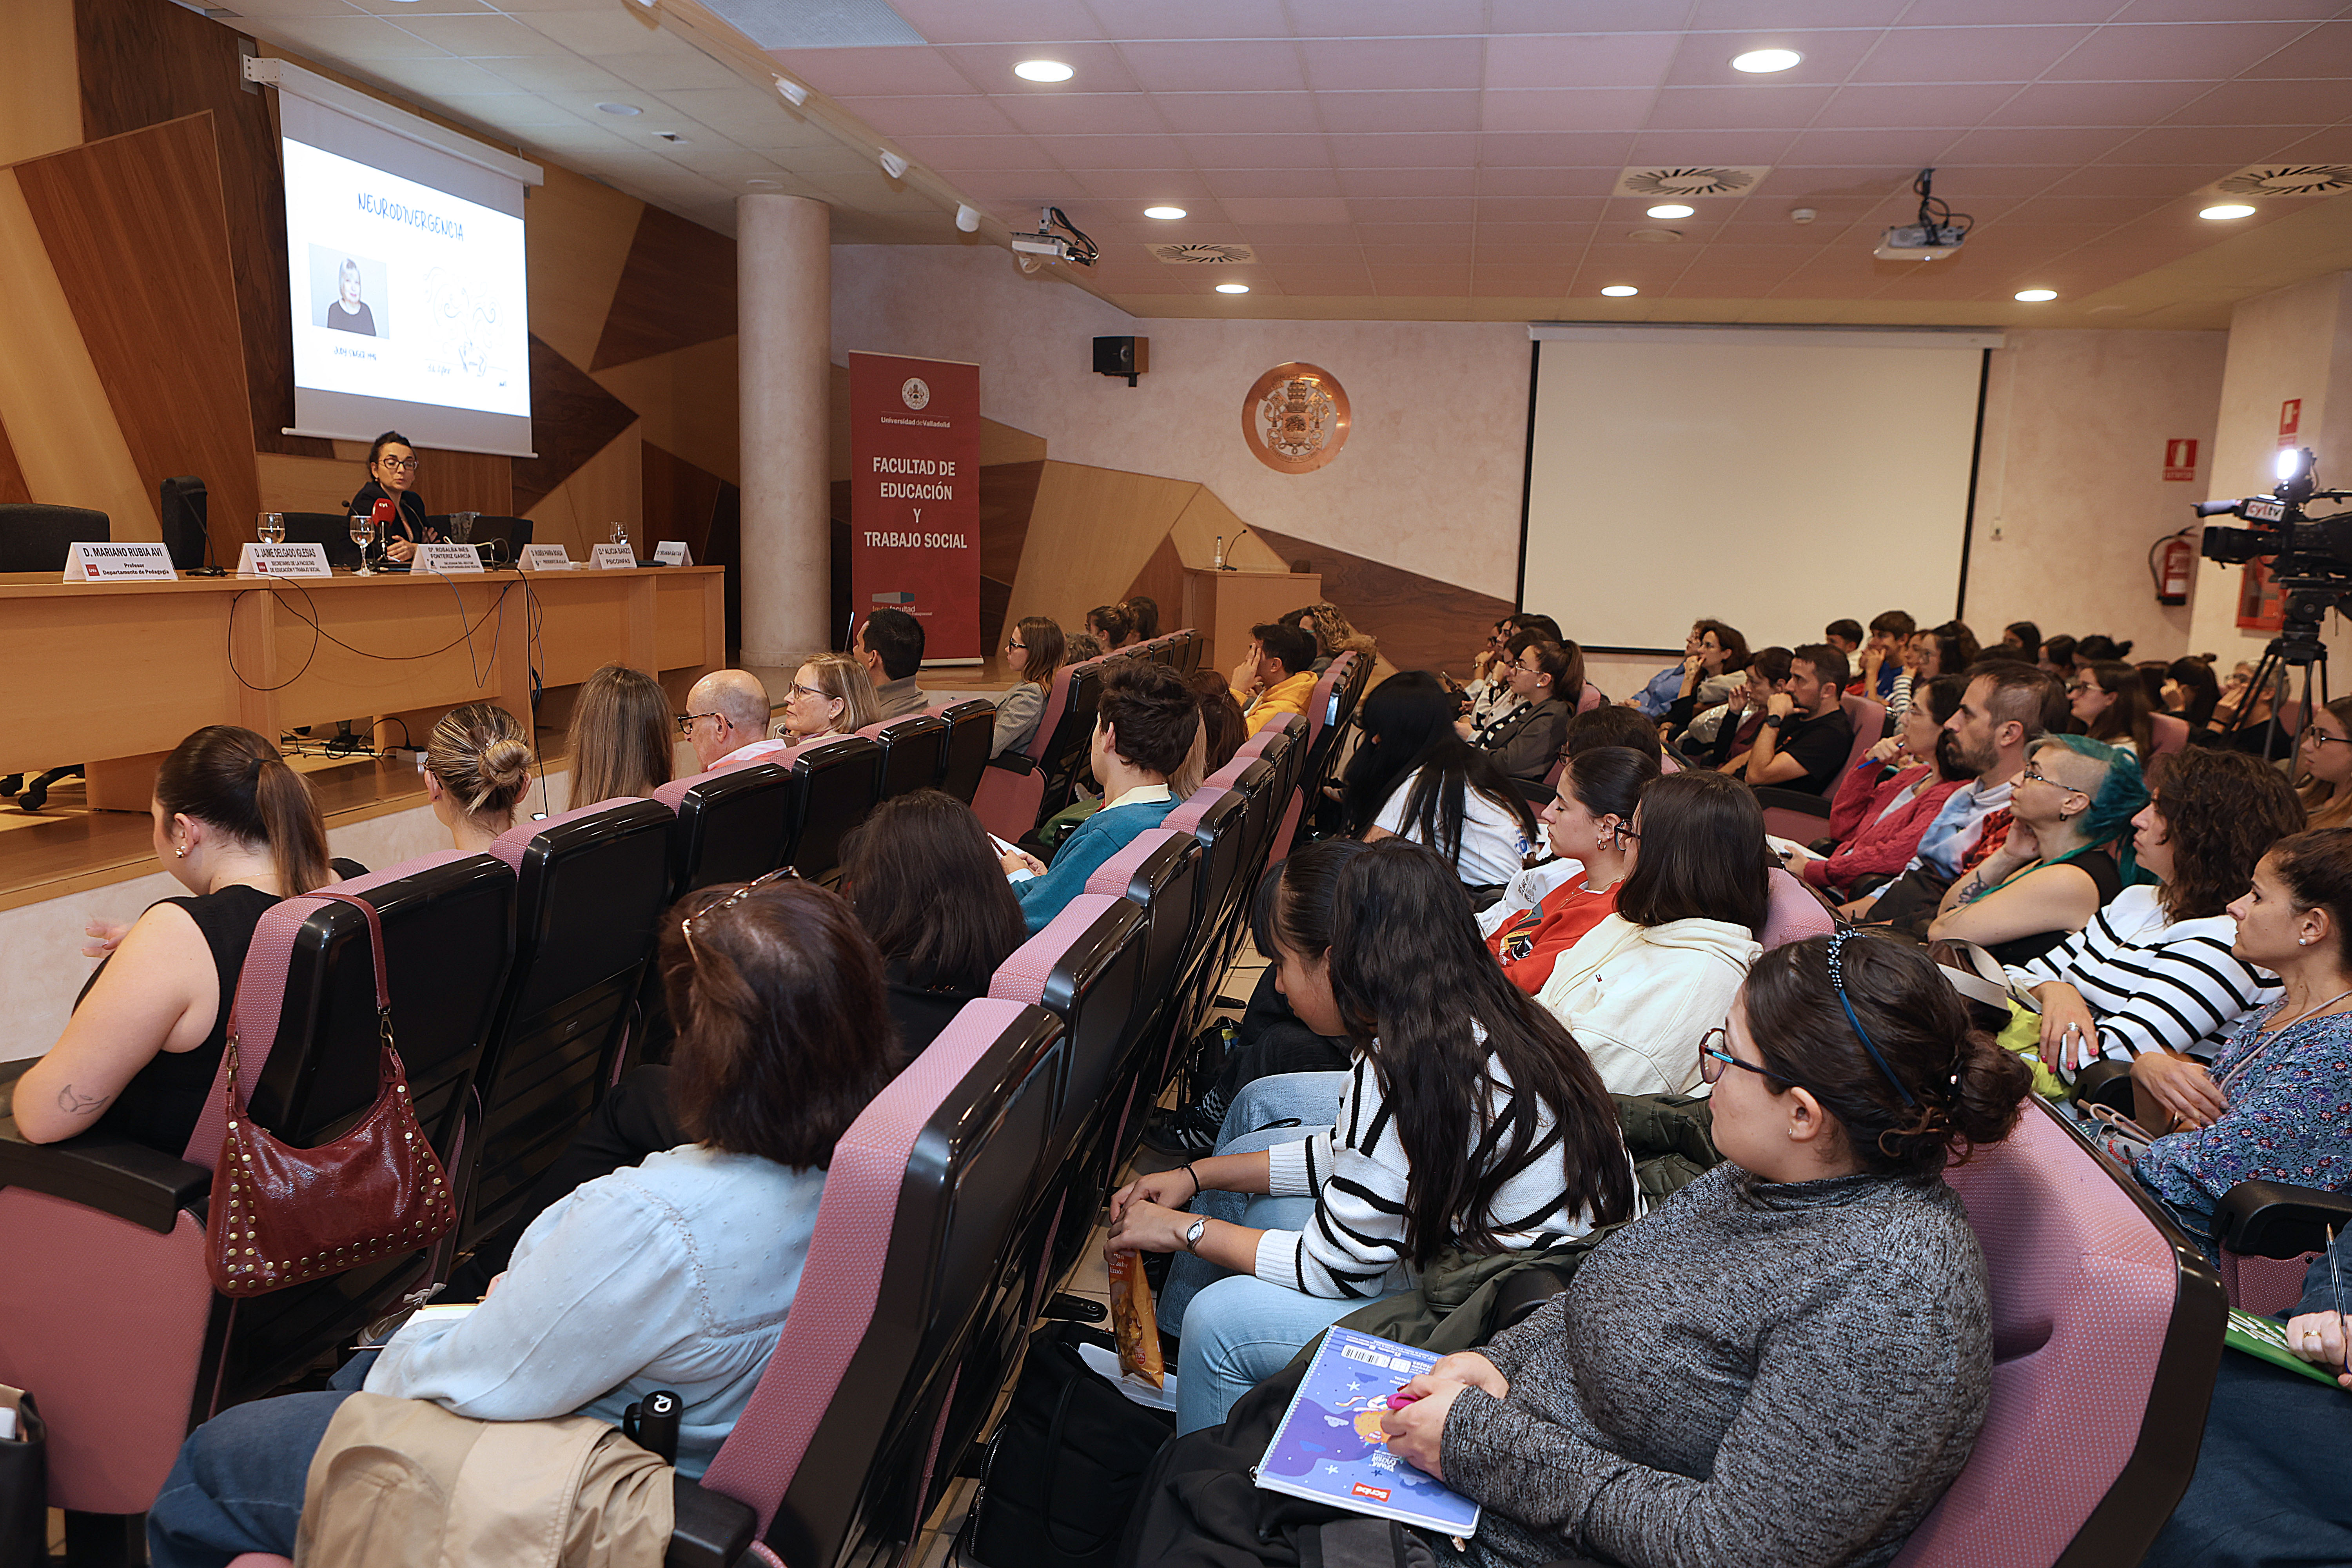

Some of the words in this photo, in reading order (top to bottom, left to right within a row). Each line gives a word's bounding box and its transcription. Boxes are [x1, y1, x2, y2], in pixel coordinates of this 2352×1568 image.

[358, 192, 463, 241] NEURODIVERGENCIA
[881, 416, 915, 425] Universidad
[923, 420, 951, 428] Valladolid
[873, 457, 936, 475] FACULTAD
[939, 461, 955, 476] DE
[880, 481, 952, 500] EDUCACIÓN
[913, 508, 921, 524] Y
[864, 531, 921, 547] TRABAJO
[924, 533, 967, 549] SOCIAL
[83, 548, 93, 557] D.
[93, 548, 127, 557] MARIANO
[128, 548, 151, 557] RUBIA
[152, 548, 163, 557] AVI
[261, 548, 274, 557] JAIME
[274, 548, 296, 557] DELGADO
[296, 548, 316, 557] IGLESIAS
[1356, 1486, 1388, 1499] Scribe
